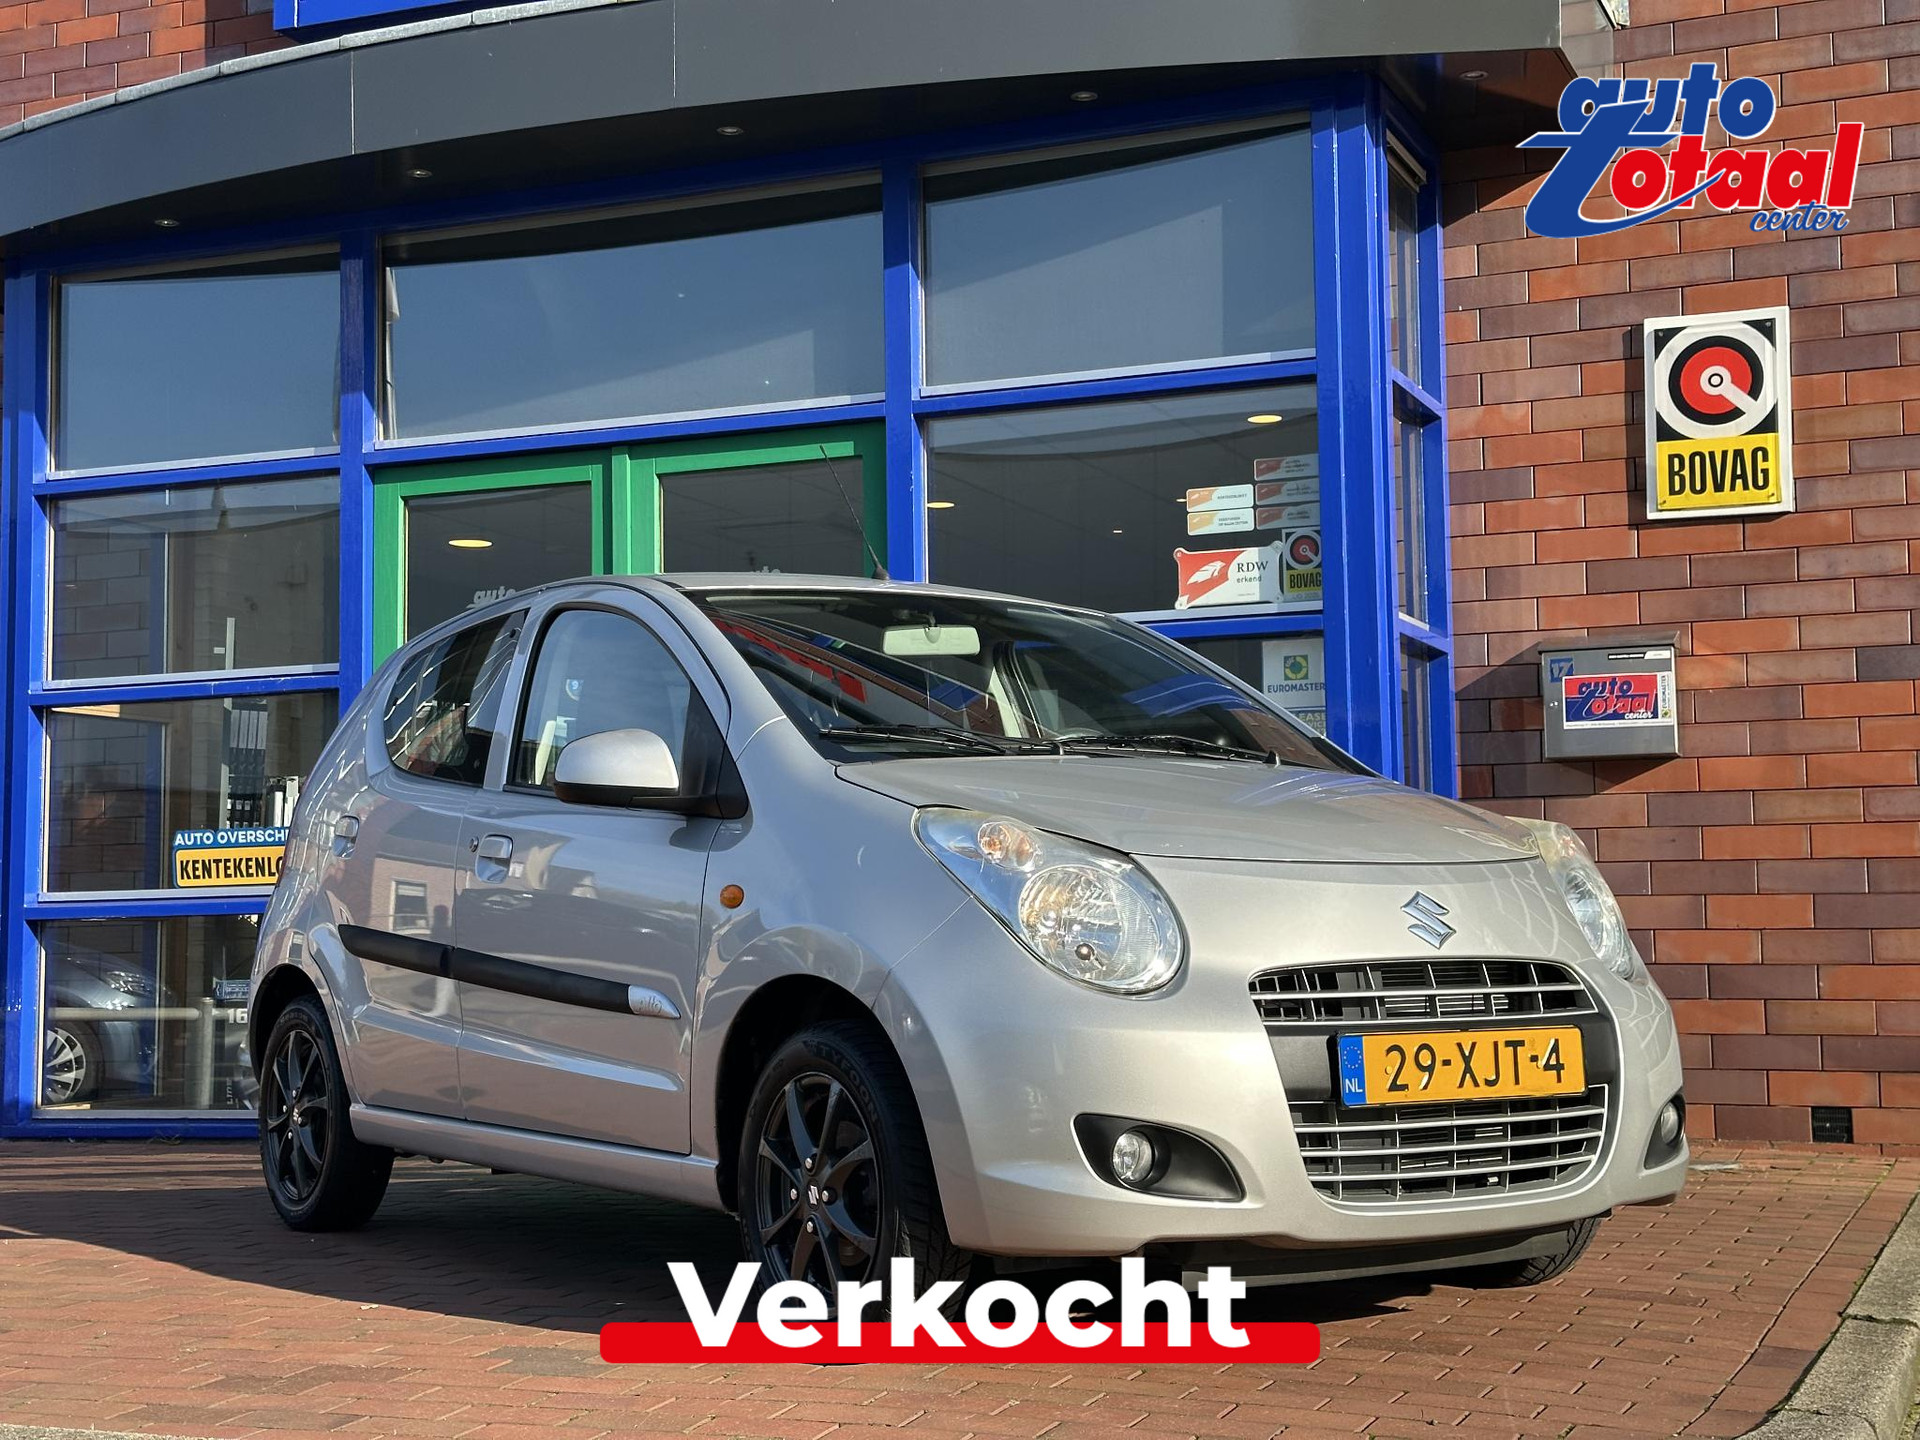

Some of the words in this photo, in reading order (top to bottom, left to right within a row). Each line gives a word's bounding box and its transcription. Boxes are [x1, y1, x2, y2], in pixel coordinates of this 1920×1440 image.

[1668, 446, 1770, 496] BOVAG
[1237, 561, 1268, 573] RDW
[1236, 575, 1262, 583] erkend
[1289, 571, 1321, 589] BOVAG
[1551, 660, 1574, 678] 17
[1267, 682, 1326, 694] EUROMASTER
[1578, 677, 1633, 697] auto
[1624, 709, 1653, 719] center
[174, 832, 214, 846] AUTO
[1385, 1038, 1565, 1092] 29-XJT-4
[1345, 1078, 1363, 1093] NL
